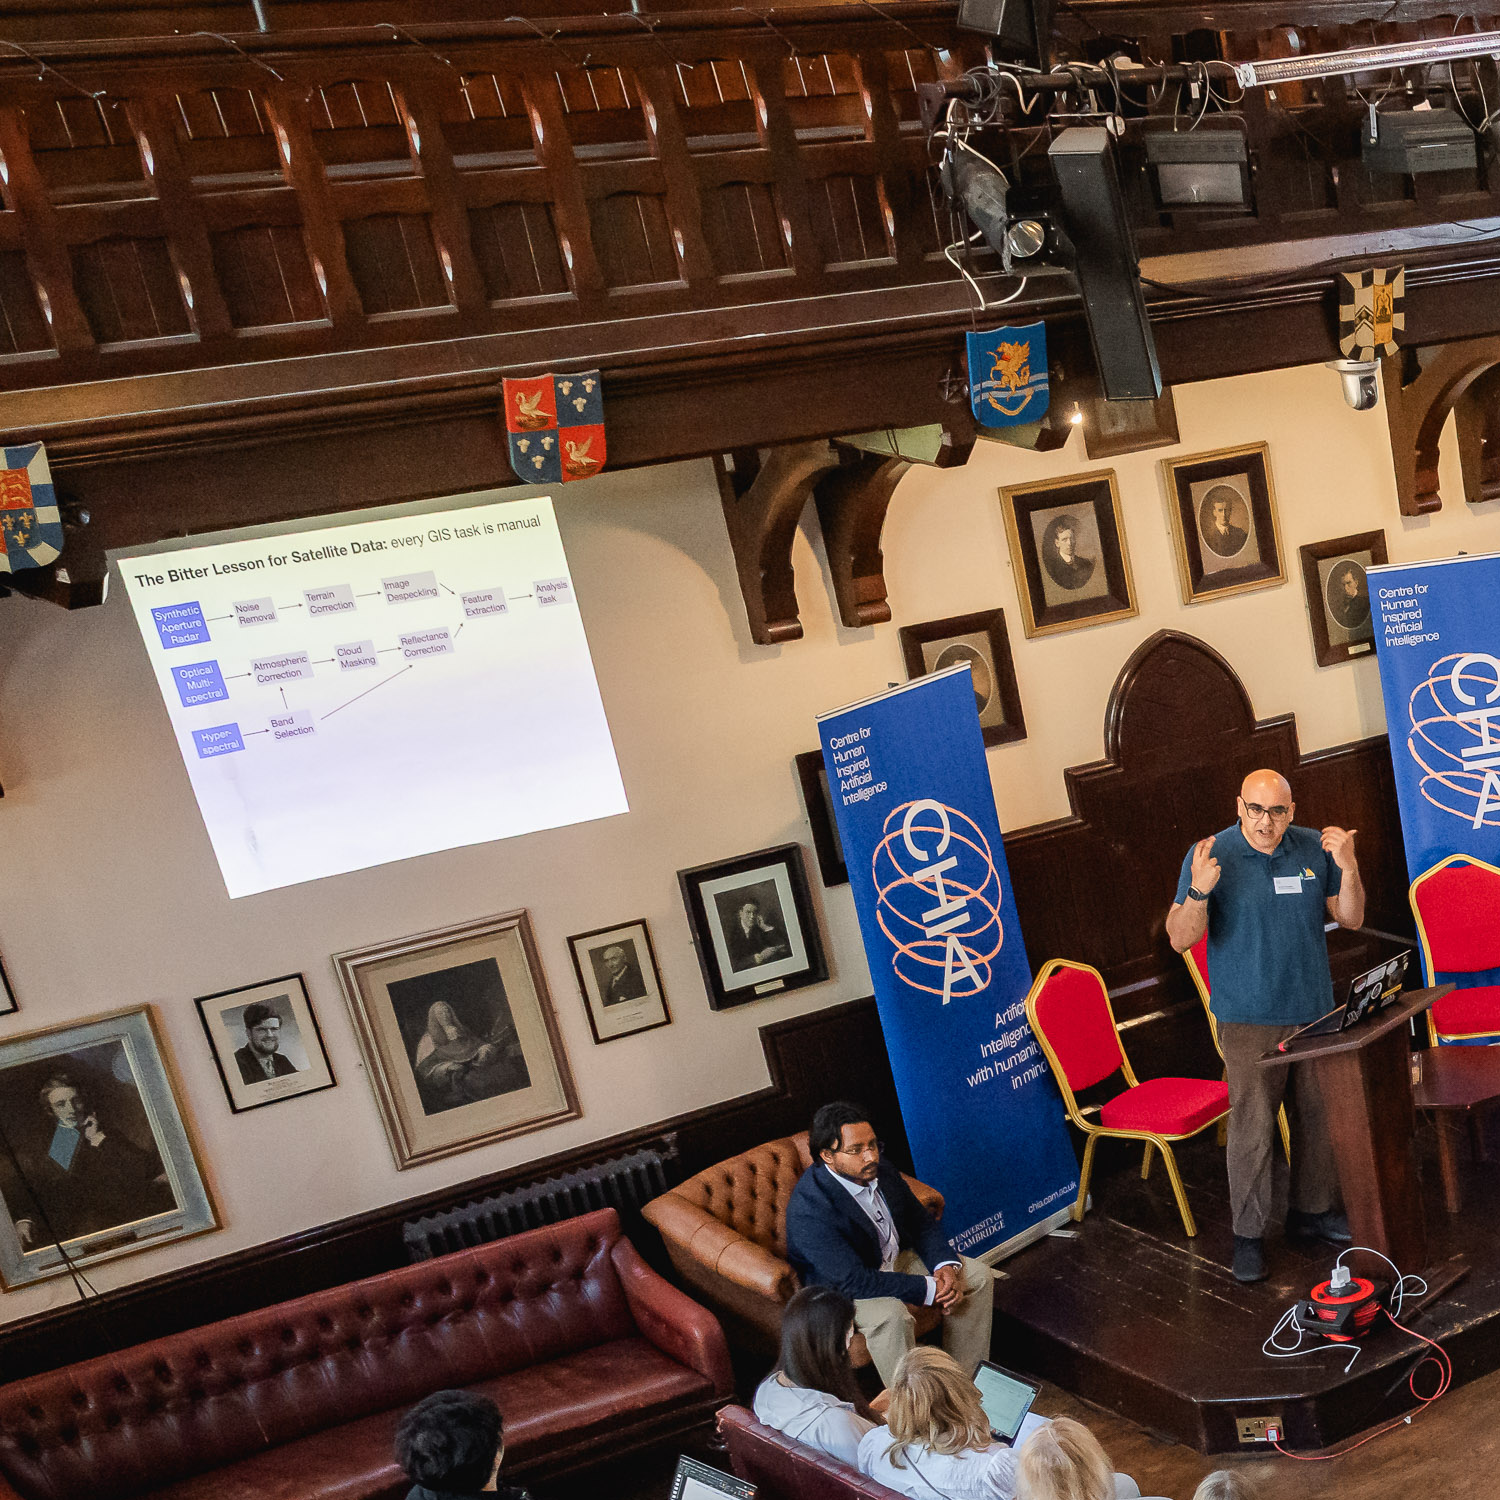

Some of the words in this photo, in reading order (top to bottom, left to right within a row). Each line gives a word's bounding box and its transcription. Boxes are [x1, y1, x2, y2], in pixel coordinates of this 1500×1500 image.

[134, 573, 165, 588] The
[167, 566, 209, 583] Bitter
[212, 559, 265, 576] Lesson
[268, 553, 288, 567] for
[291, 543, 348, 564] Satellite
[351, 538, 389, 555] Data:
[391, 531, 425, 549] every
[428, 528, 452, 543] GIS
[454, 524, 482, 540] task
[483, 522, 494, 535] is
[497, 514, 541, 533] manual
[383, 579, 410, 591] Image
[535, 580, 568, 593] Analysis
[1378, 586, 1414, 599] Centre
[1414, 583, 1429, 595] for
[305, 591, 336, 603] Terrain
[387, 587, 438, 603] Despeckling
[462, 592, 493, 605] Feature
[539, 594, 557, 605] Task
[235, 603, 260, 614] Noise
[310, 601, 354, 615] Correction
[465, 602, 506, 617] Extraction
[1380, 598, 1418, 611] Human
[154, 605, 200, 622] Synthetic
[239, 612, 276, 625] Removal
[1382, 608, 1423, 625] Inspired
[161, 619, 202, 634] Aperture
[1384, 619, 1423, 635] Artificial
[170, 632, 200, 645] Radar
[400, 631, 449, 646] Reflectance
[1385, 632, 1440, 647] Intelligence
[337, 645, 362, 657] Cloud
[404, 644, 447, 658] Correction
[253, 655, 308, 672] Atmospheric
[340, 656, 376, 670] Masking
[179, 665, 214, 680] Optical
[257, 669, 302, 683] Correction
[186, 678, 214, 690] Multi-
[185, 689, 224, 705] spectral
[270, 717, 294, 728] Band
[201, 728, 232, 743] Hyper-
[274, 725, 315, 740] Selection
[830, 732, 860, 750] Centre
[859, 727, 872, 739] for
[202, 739, 240, 756] spectral
[833, 745, 866, 765] Human
[836, 755, 870, 778] Inspired
[841, 770, 873, 793] Artificial
[842, 781, 888, 806] Intelligence
[903, 798, 985, 1006] CHIA
[995, 998, 1025, 1029] Artifici
[980, 1022, 1033, 1058] Intelligenc
[966, 1065, 994, 1088] with
[1010, 1075, 1023, 1090] in
[954, 1214, 994, 1243] UNIVERSITY
[993, 1210, 1004, 1221] OF
[957, 1219, 1006, 1253] CAMBRIDGE
